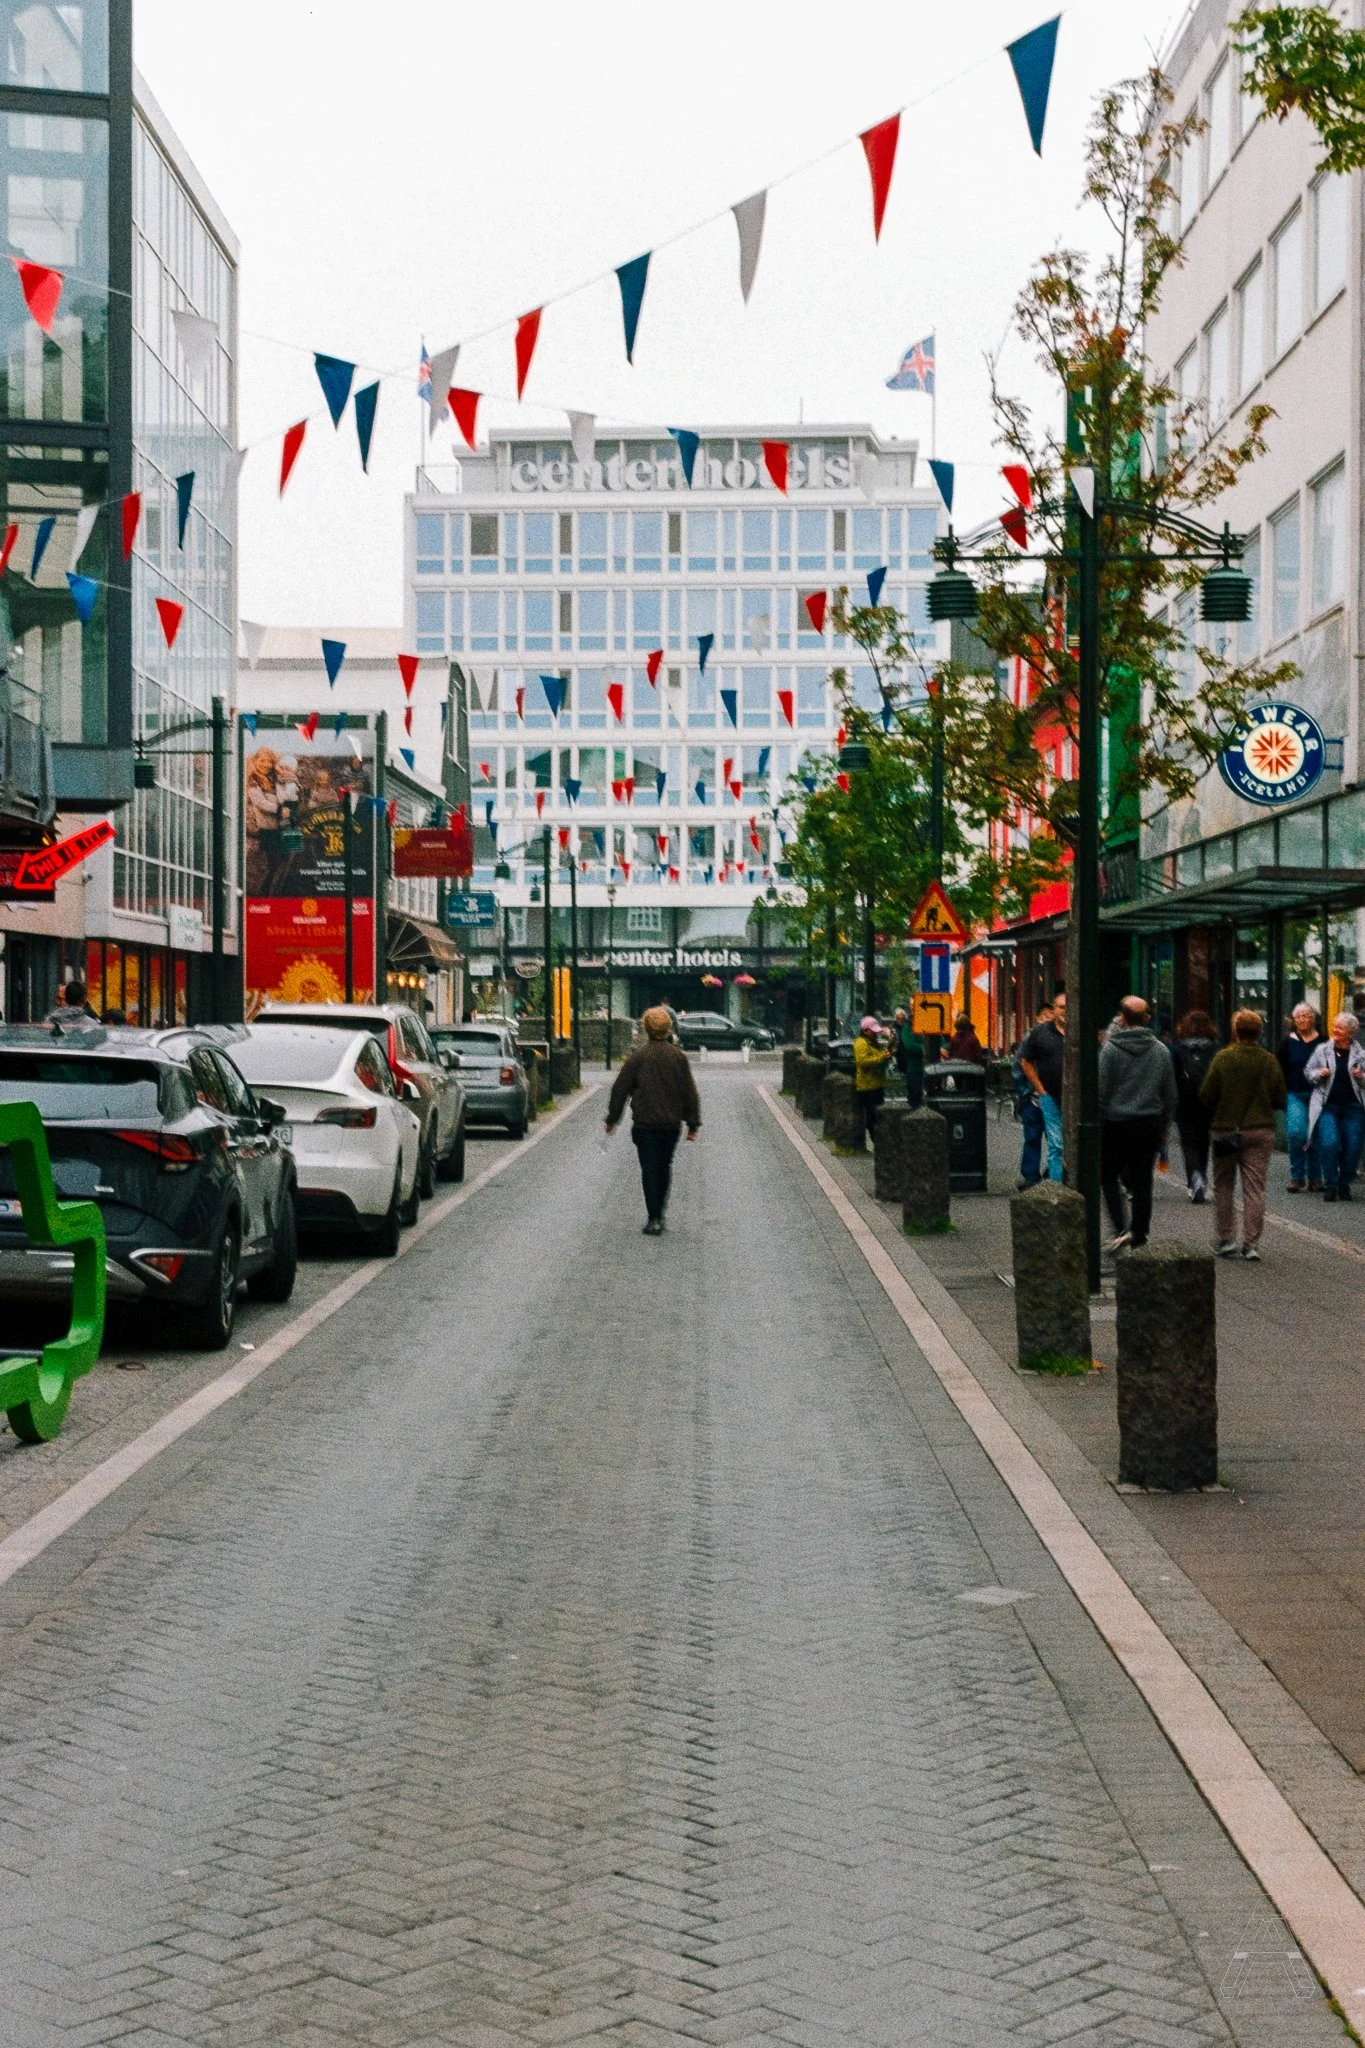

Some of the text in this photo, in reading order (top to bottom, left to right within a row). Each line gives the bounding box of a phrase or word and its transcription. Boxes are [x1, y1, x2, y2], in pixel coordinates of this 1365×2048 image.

[511, 451, 678, 492] center
[604, 948, 743, 967] center hotels
